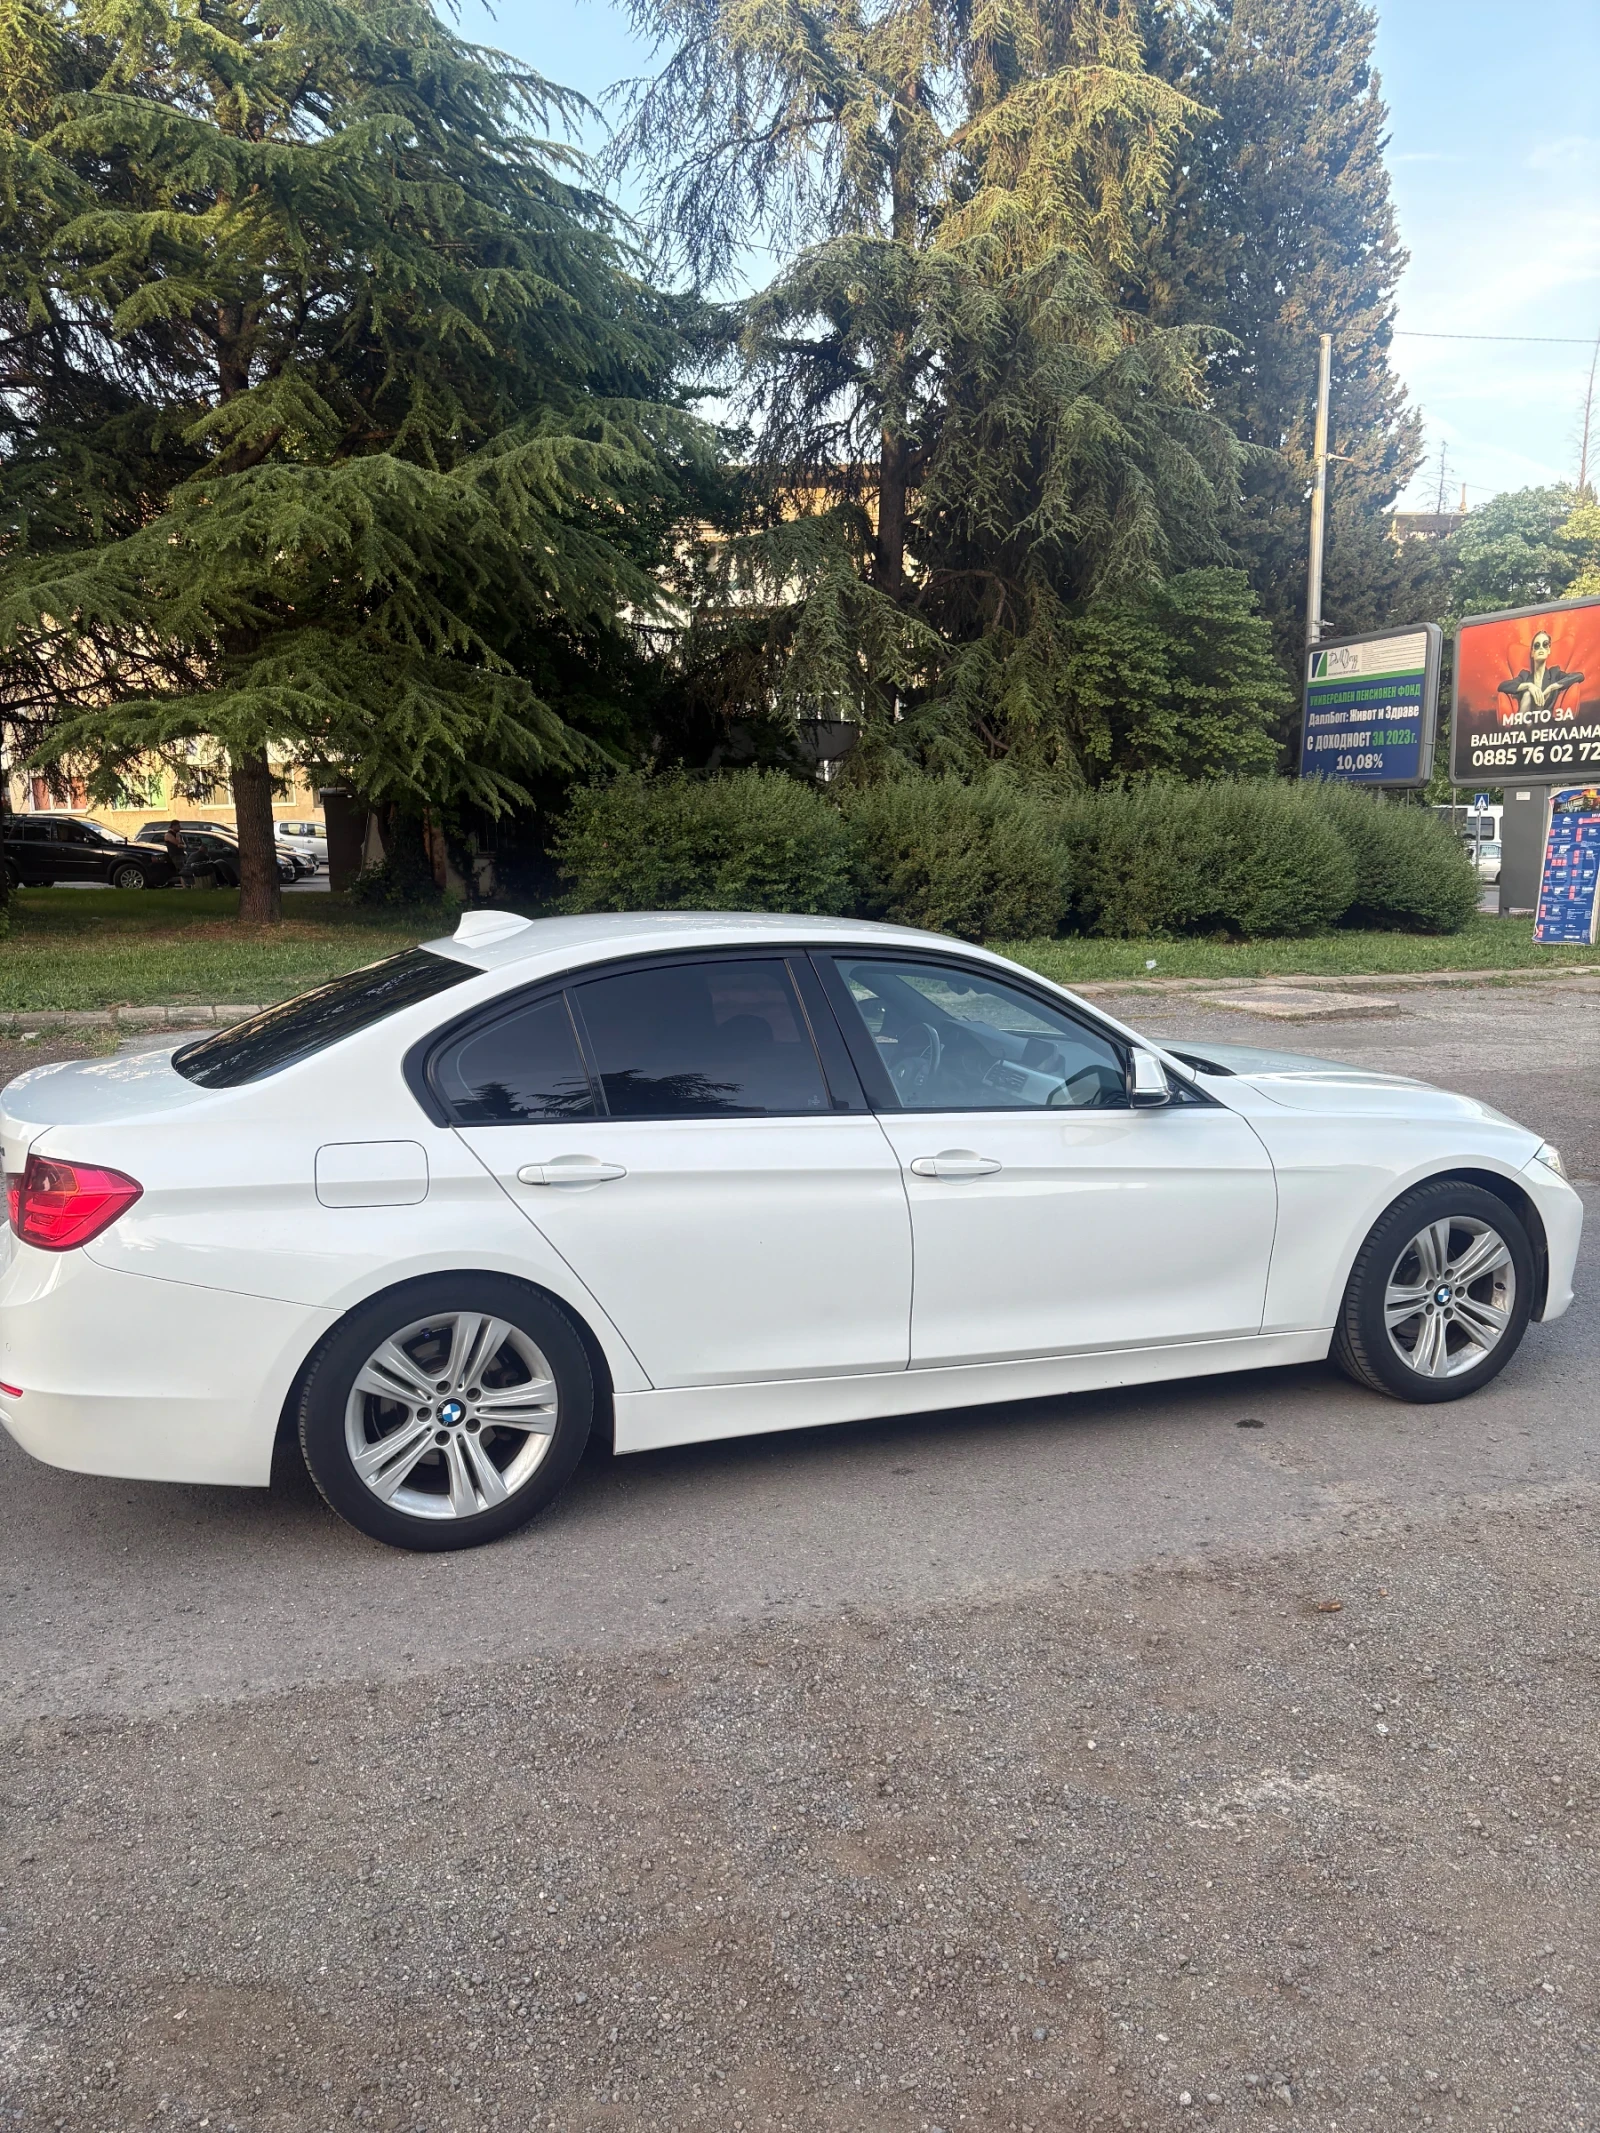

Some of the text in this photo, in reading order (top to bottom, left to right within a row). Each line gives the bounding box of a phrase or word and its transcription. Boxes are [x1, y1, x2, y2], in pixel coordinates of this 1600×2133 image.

[1310, 683, 1421, 706] УНИВЕРСАЛЕН ПЕНСИОНЕН ФОНД
[1349, 709, 1377, 722] Живот
[1377, 708, 1385, 720] и
[1385, 705, 1420, 720] Здраве
[1502, 707, 1574, 726] МЯСТО ЗА
[1307, 735, 1314, 751] С
[1314, 731, 1371, 752] ДОХОДНОСТ
[1372, 731, 1384, 746] ЗА
[1470, 724, 1600, 747] ВАШАТА РЕКЛАМА
[1336, 753, 1384, 772] 10,08%
[1472, 741, 1600, 767] 0885 76 02 72
